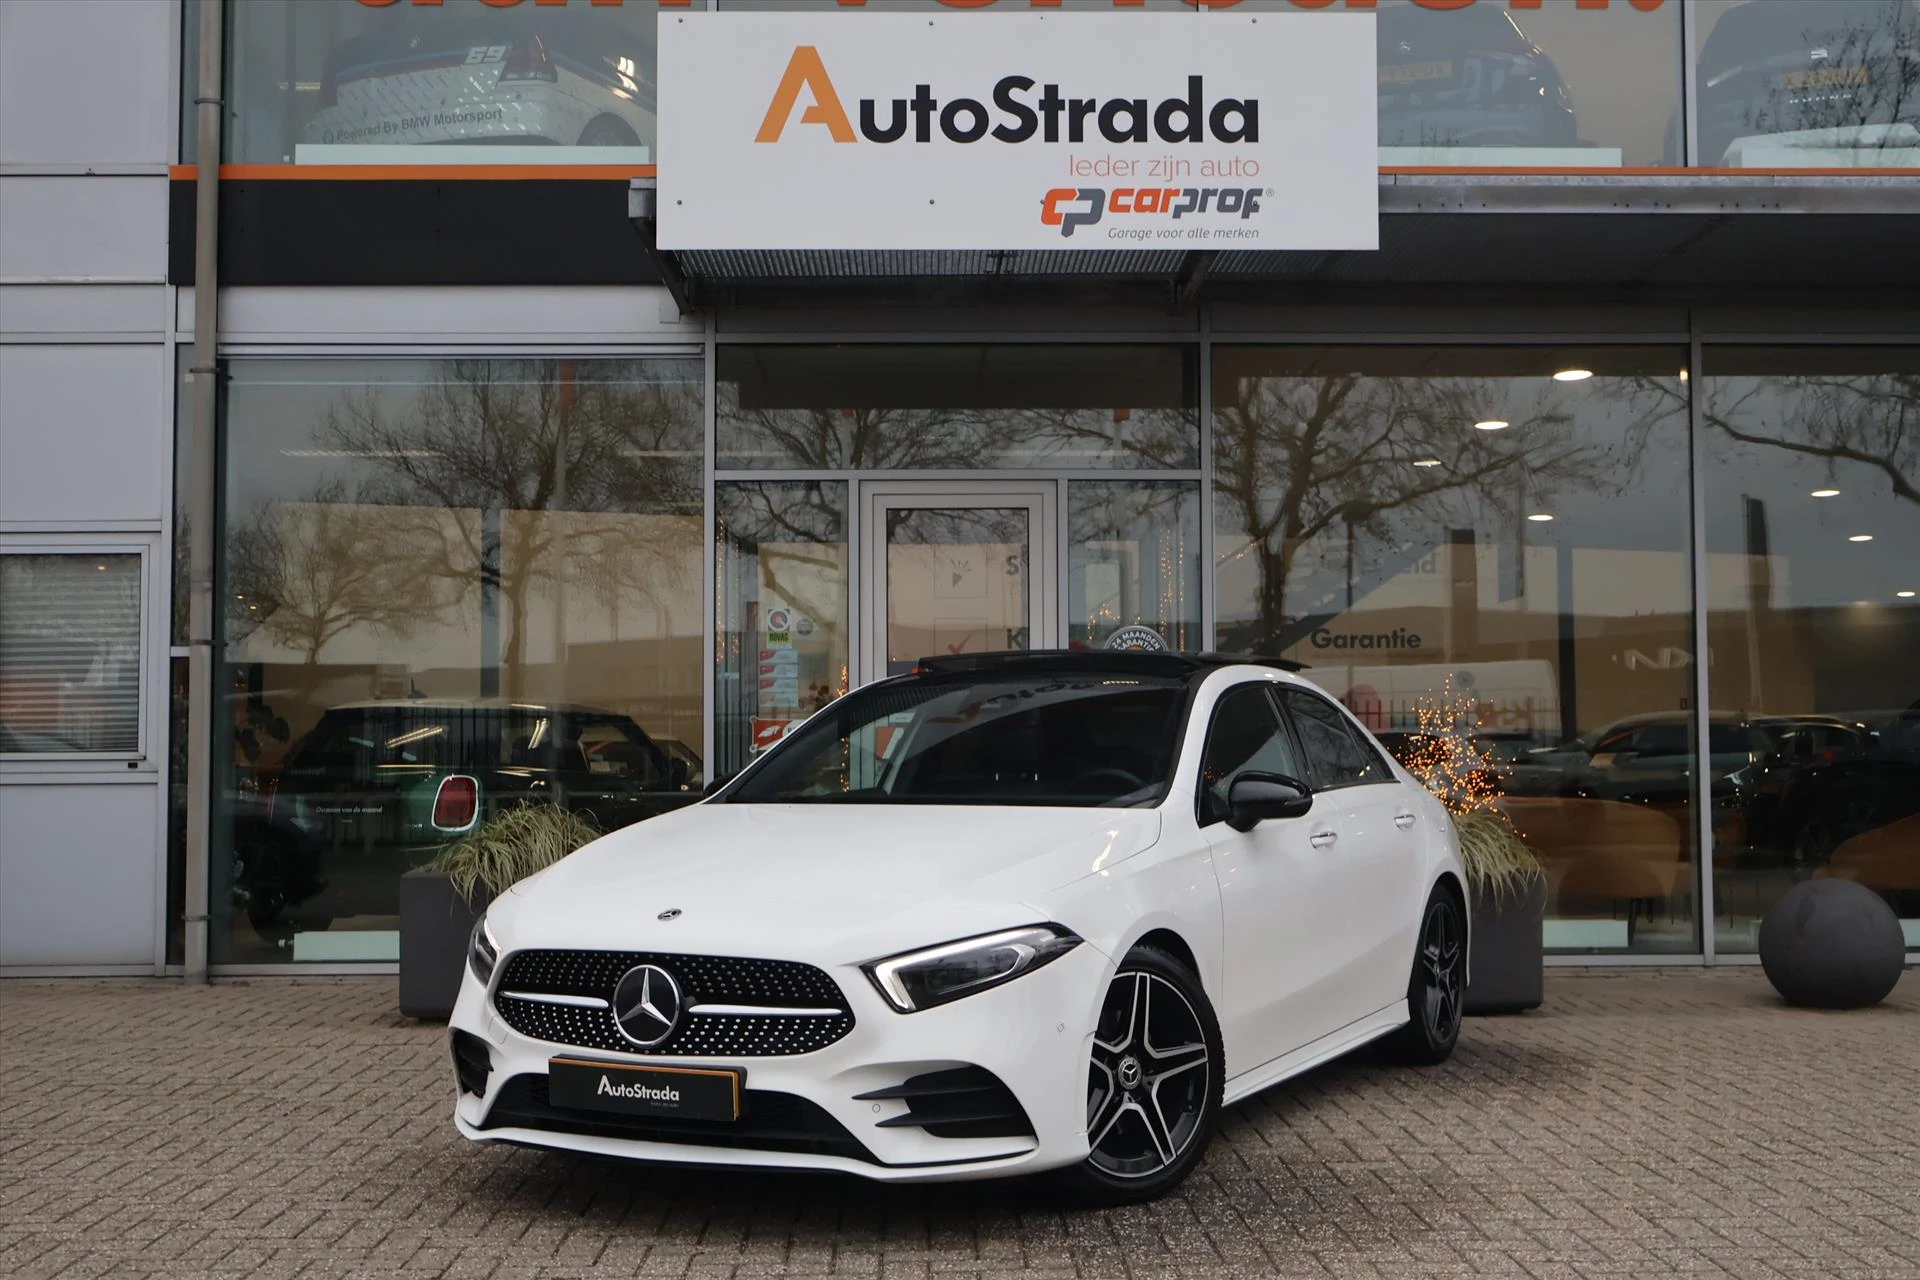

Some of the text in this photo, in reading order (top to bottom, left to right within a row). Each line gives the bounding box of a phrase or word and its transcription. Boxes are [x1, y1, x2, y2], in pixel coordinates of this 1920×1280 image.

[754, 45, 1259, 144] AutoStrada
[336, 108, 503, 141] Powered By BMW Motorsport
[1069, 153, 1260, 183] Ieder zijn auto
[1108, 227, 1259, 242] Garage voor alle merken
[1121, 631, 1161, 650] MAANDEN
[1310, 627, 1422, 649] Garantie
[597, 1074, 680, 1102] AutoStrada
